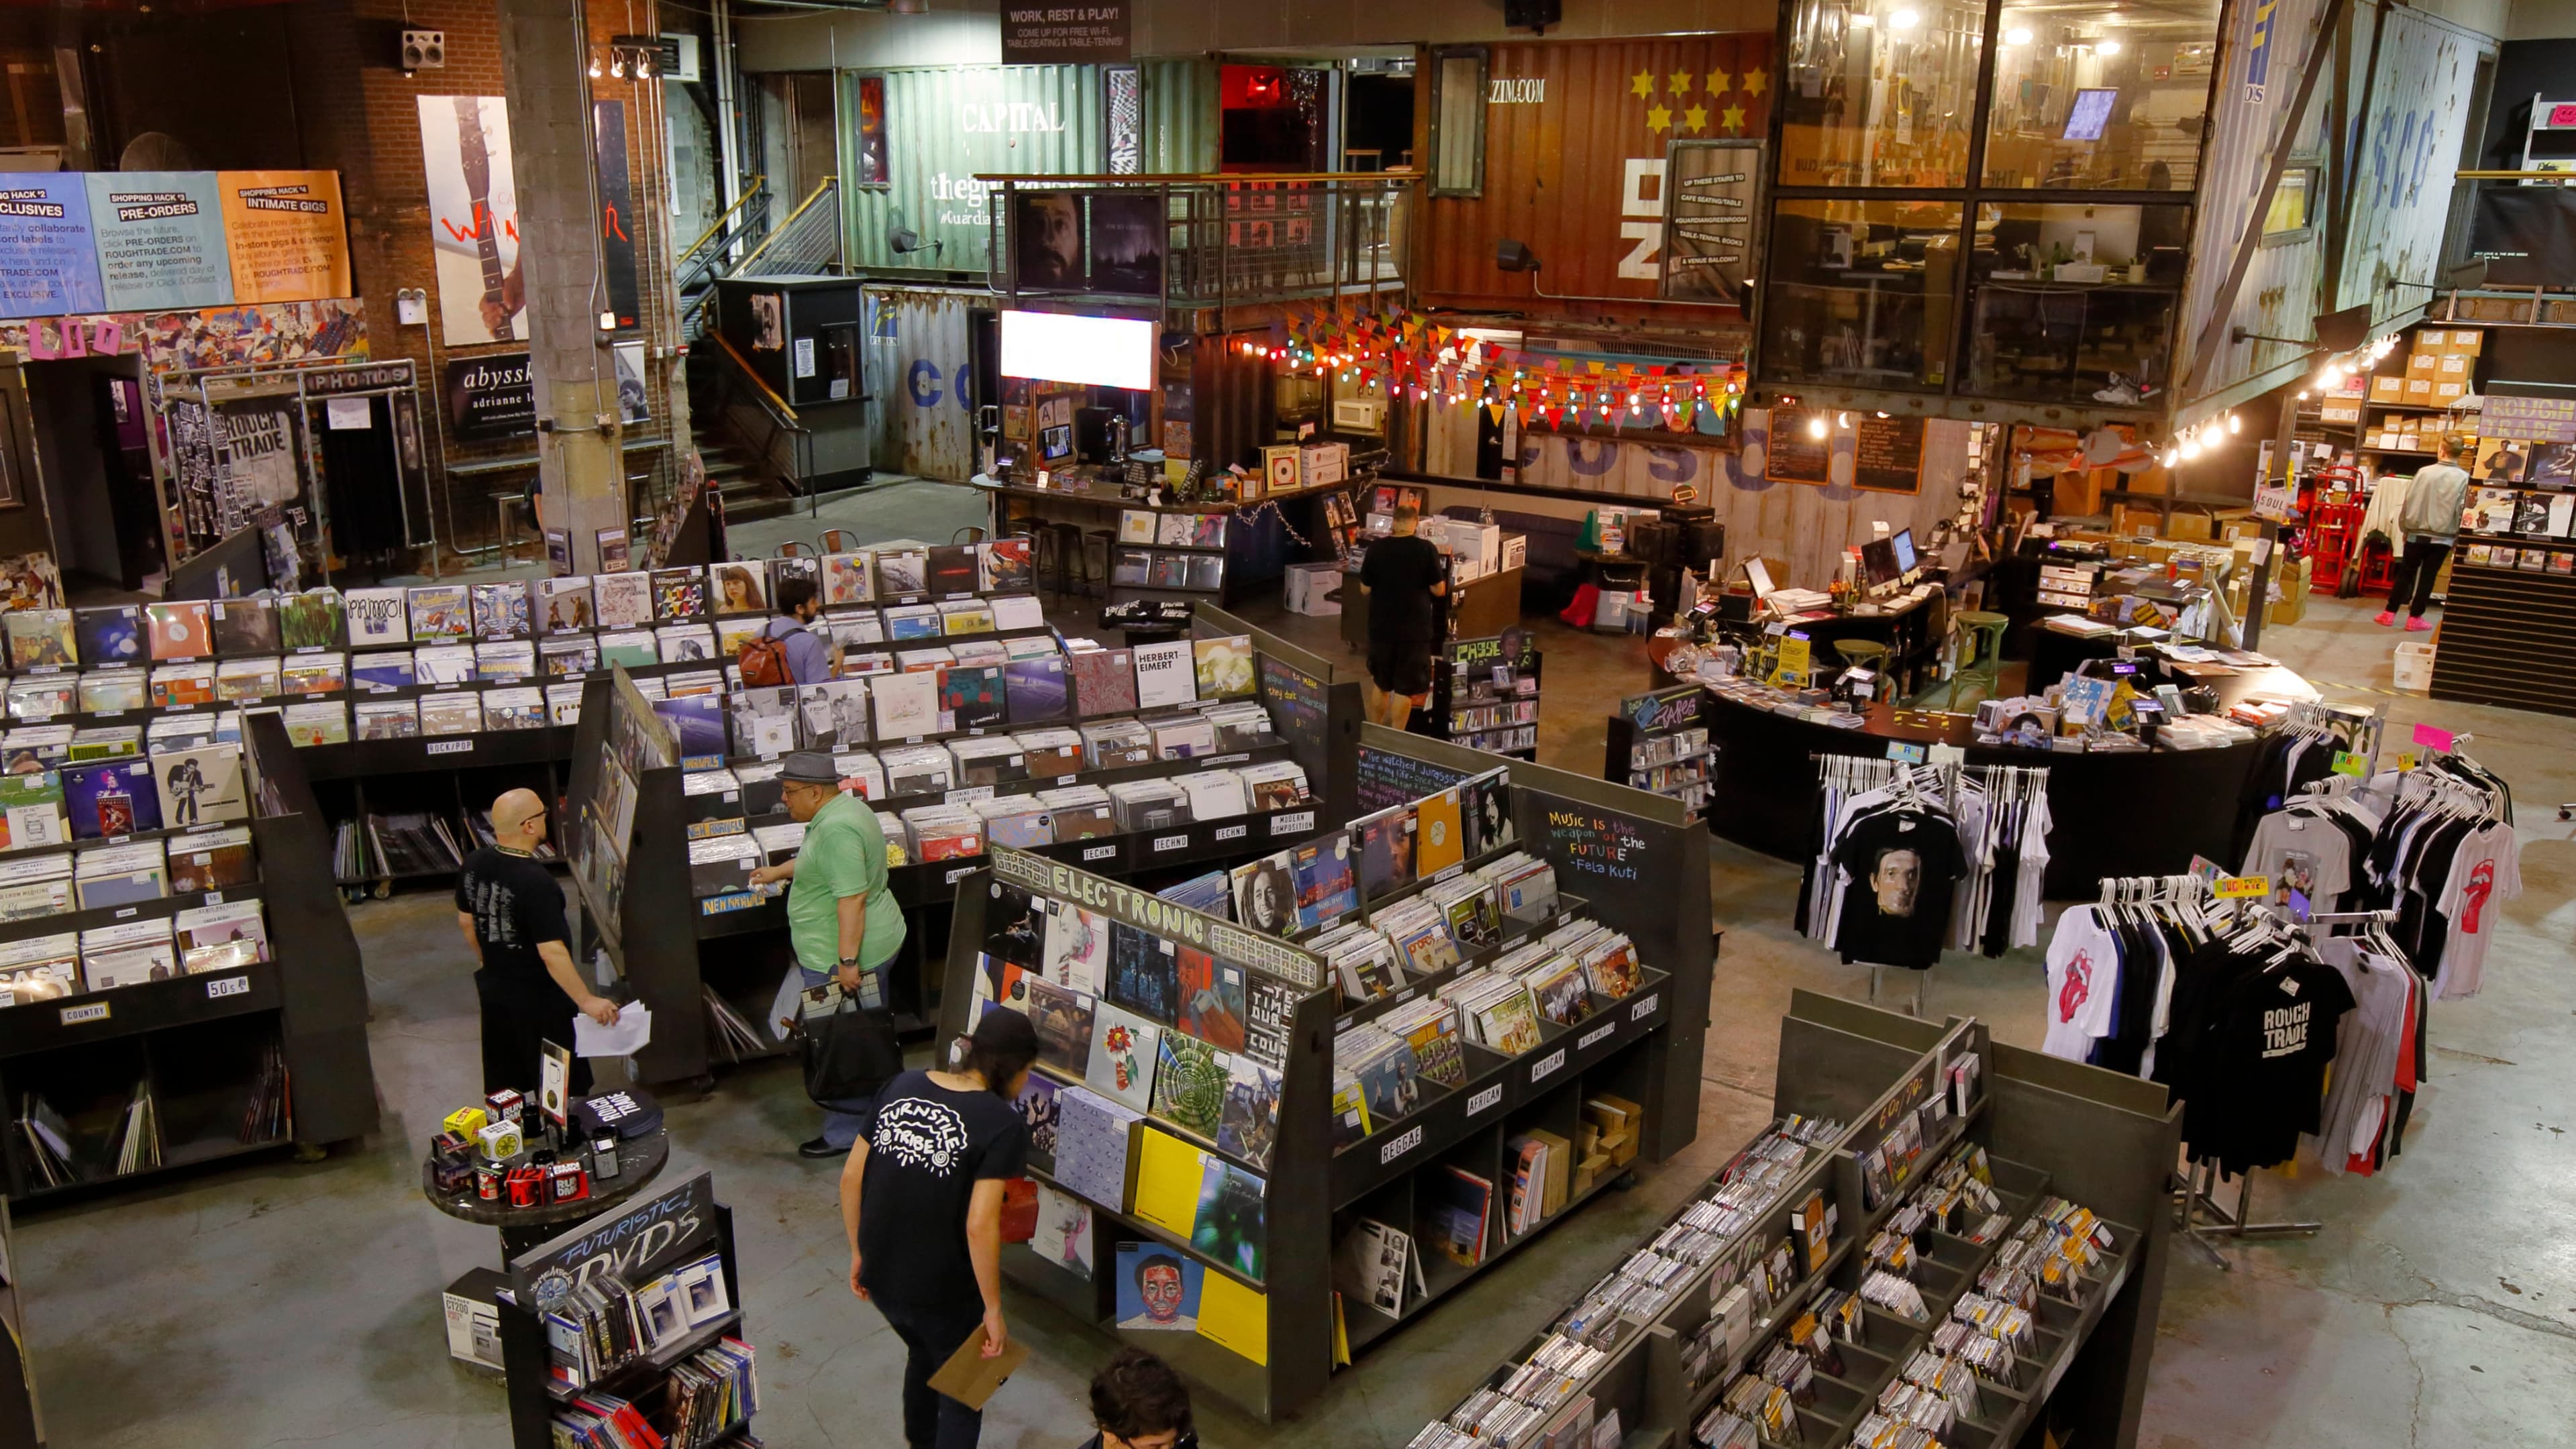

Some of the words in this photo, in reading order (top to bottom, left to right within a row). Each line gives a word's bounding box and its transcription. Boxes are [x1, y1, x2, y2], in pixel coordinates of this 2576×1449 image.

[1011, 11, 1045, 23] WORK,
[1047, 9, 1076, 21] REST
[1078, 9, 1085, 20] &
[1088, 8, 1119, 20] PLAY!
[1017, 28, 1039, 38] COME
[1041, 28, 1051, 36] UP
[1053, 28, 1068, 36] FOR
[1070, 28, 1088, 36] FREE
[964, 102, 1066, 133] CAPITAL
[1694, 177, 1713, 185] THESE
[1714, 175, 1735, 183] STAIRS
[154, 193, 176, 201] HACK
[240, 189, 277, 197] SHOPPING
[278, 186, 299, 195] HACK
[119, 203, 197, 220] PRE-ORDERS
[248, 198, 298, 210] INTIMATE
[300, 201, 326, 212] GIGS
[28, 224, 86, 233] collaborate
[125, 235, 183, 246] PRE-ORDERS
[236, 241, 268, 250] In-store
[271, 238, 289, 248] gigs
[1722, 238, 1743, 246] BOOKS
[105, 246, 191, 258] ROUGHTRADE.COM
[136, 260, 154, 268] any
[156, 256, 202, 268] upcoming
[315, 368, 409, 390] PHOTOS
[473, 396, 521, 408] adrianne
[230, 431, 287, 461] TRADE
[2260, 498, 2284, 511] SOUL
[655, 577, 685, 585] Villagers
[1139, 651, 1179, 663] HERBERT
[1140, 661, 1172, 672] EIMERT
[1268, 688, 1283, 701] they
[429, 741, 471, 752] ROCK/POP
[1382, 755, 1416, 771] watched
[1421, 766, 1457, 784] Jurassic
[1059, 776, 1076, 785] TECHNO
[1280, 813, 1305, 824] MODERN
[1217, 826, 1245, 839] TECHNO
[1272, 821, 1313, 834] COMPOSITION
[1612, 820, 1635, 836] the
[1155, 837, 1187, 850] TECHNO
[1551, 828, 1595, 843] weapon
[1620, 835, 1645, 849] the
[1085, 847, 1115, 860] TECHNO
[1570, 843, 1627, 861] FUTURE
[705, 900, 725, 914] NEW
[1052, 866, 1204, 944] ELECTRONIC
[1323, 919, 1339, 930] AFRICAN
[67, 1007, 103, 1020] COUNTRY
[1633, 996, 1657, 1018] WORLD
[2264, 1002, 2310, 1030] ROUGH
[1580, 1034, 1596, 1049] LATIN
[1595, 1022, 1615, 1042] AMERICA
[2264, 1022, 2308, 1049] TRADE
[1533, 1051, 1563, 1080] AFRICAN
[1469, 1085, 1500, 1114] AFRICAN
[881, 1102, 960, 1153] TURNSTILE
[893, 1128, 934, 1153] TRIBE
[1384, 1127, 1421, 1161] REGGAE
[446, 1299, 468, 1315] CT200
